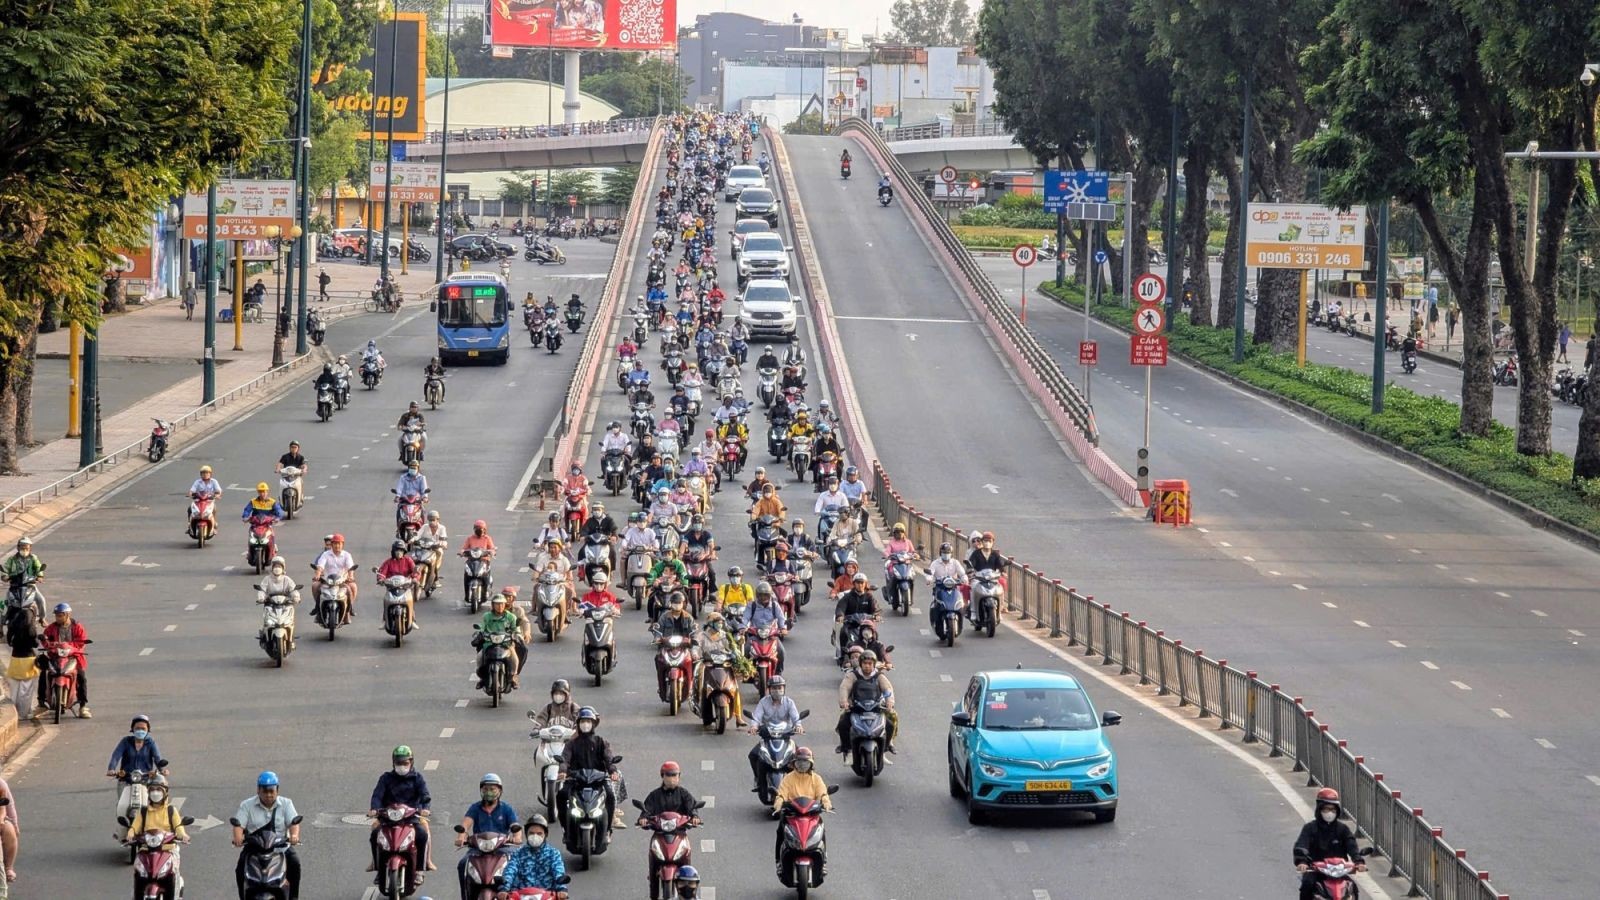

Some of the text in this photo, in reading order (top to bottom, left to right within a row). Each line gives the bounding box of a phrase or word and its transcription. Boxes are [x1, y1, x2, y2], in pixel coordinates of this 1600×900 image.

[945, 170, 952, 178] 30
[400, 192, 415, 200] 331
[418, 192, 434, 200] 246
[232, 225, 257, 235] 343
[1019, 250, 1029, 260] 40
[1258, 252, 1350, 265] 0906 331 246
